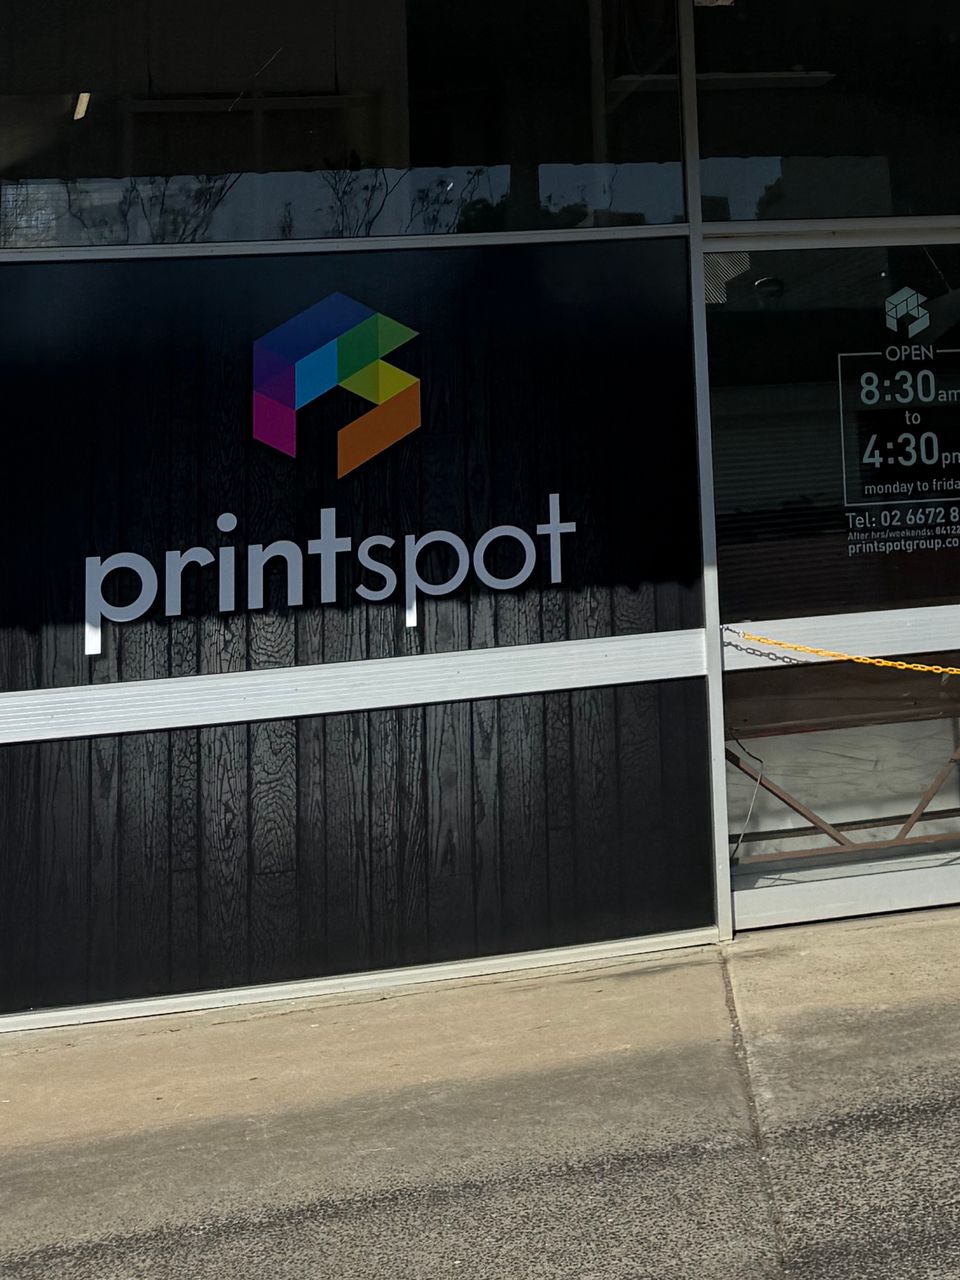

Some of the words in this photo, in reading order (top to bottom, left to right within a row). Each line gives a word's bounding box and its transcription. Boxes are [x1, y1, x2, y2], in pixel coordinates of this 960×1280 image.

[885, 345, 934, 361] OPEN
[905, 410, 921, 425] to
[864, 481, 914, 495] monday
[916, 480, 929, 492] to
[845, 511, 877, 528] Tel:
[881, 510, 901, 527] 02
[906, 507, 946, 525] 6672
[84, 493, 576, 654] printspot
